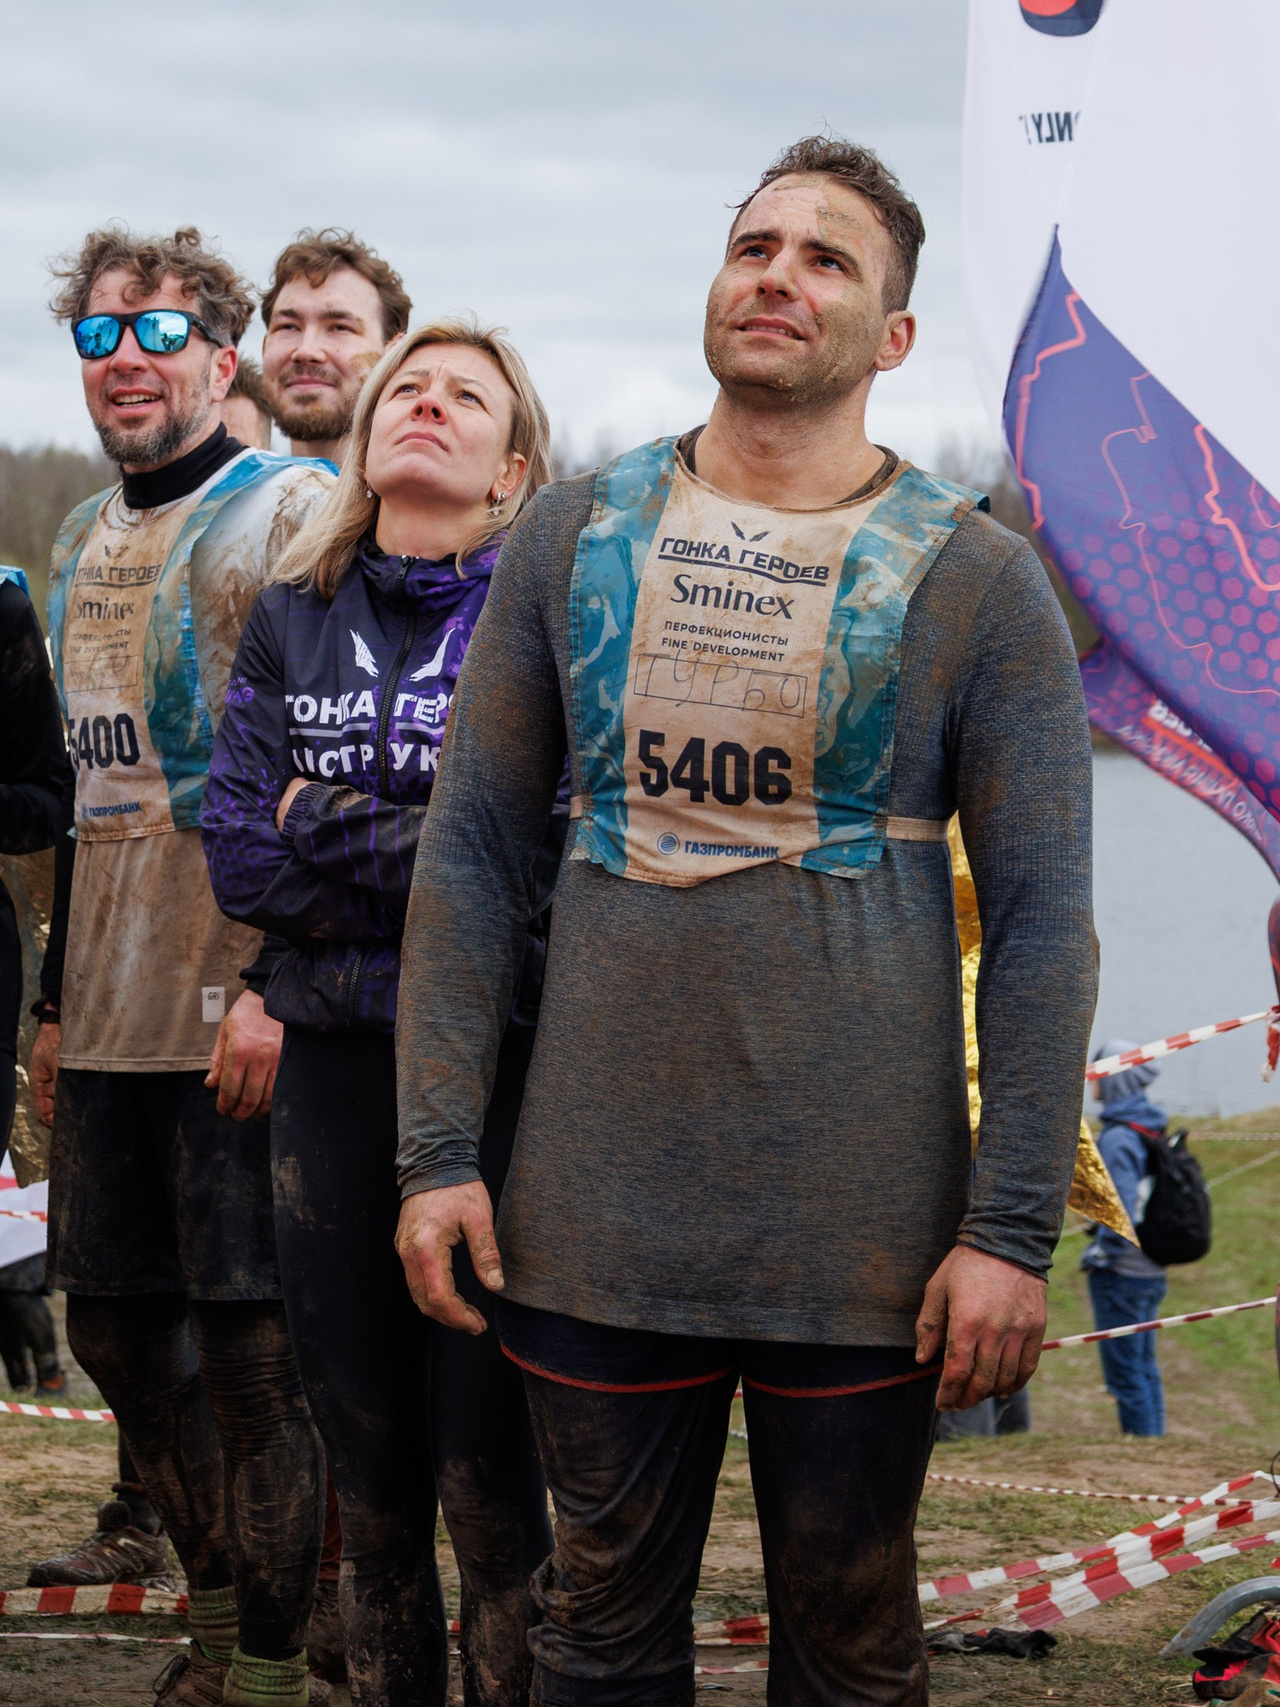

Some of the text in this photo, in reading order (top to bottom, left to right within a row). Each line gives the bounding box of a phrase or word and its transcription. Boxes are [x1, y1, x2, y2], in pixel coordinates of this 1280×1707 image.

[660, 537, 830, 581] ГОНКА ГЕРОЕВ
[670, 574, 795, 620] Sminex
[664, 621, 789, 646] ПЕРФЕКЦИОНИСТЫ
[661, 637, 785, 662] FINE DEVELOPMENT
[638, 730, 792, 806] 5406
[89, 801, 142, 818] ГАЗПРОМБАНК
[684, 840, 780, 859] ГАЗПРОМБАНК
